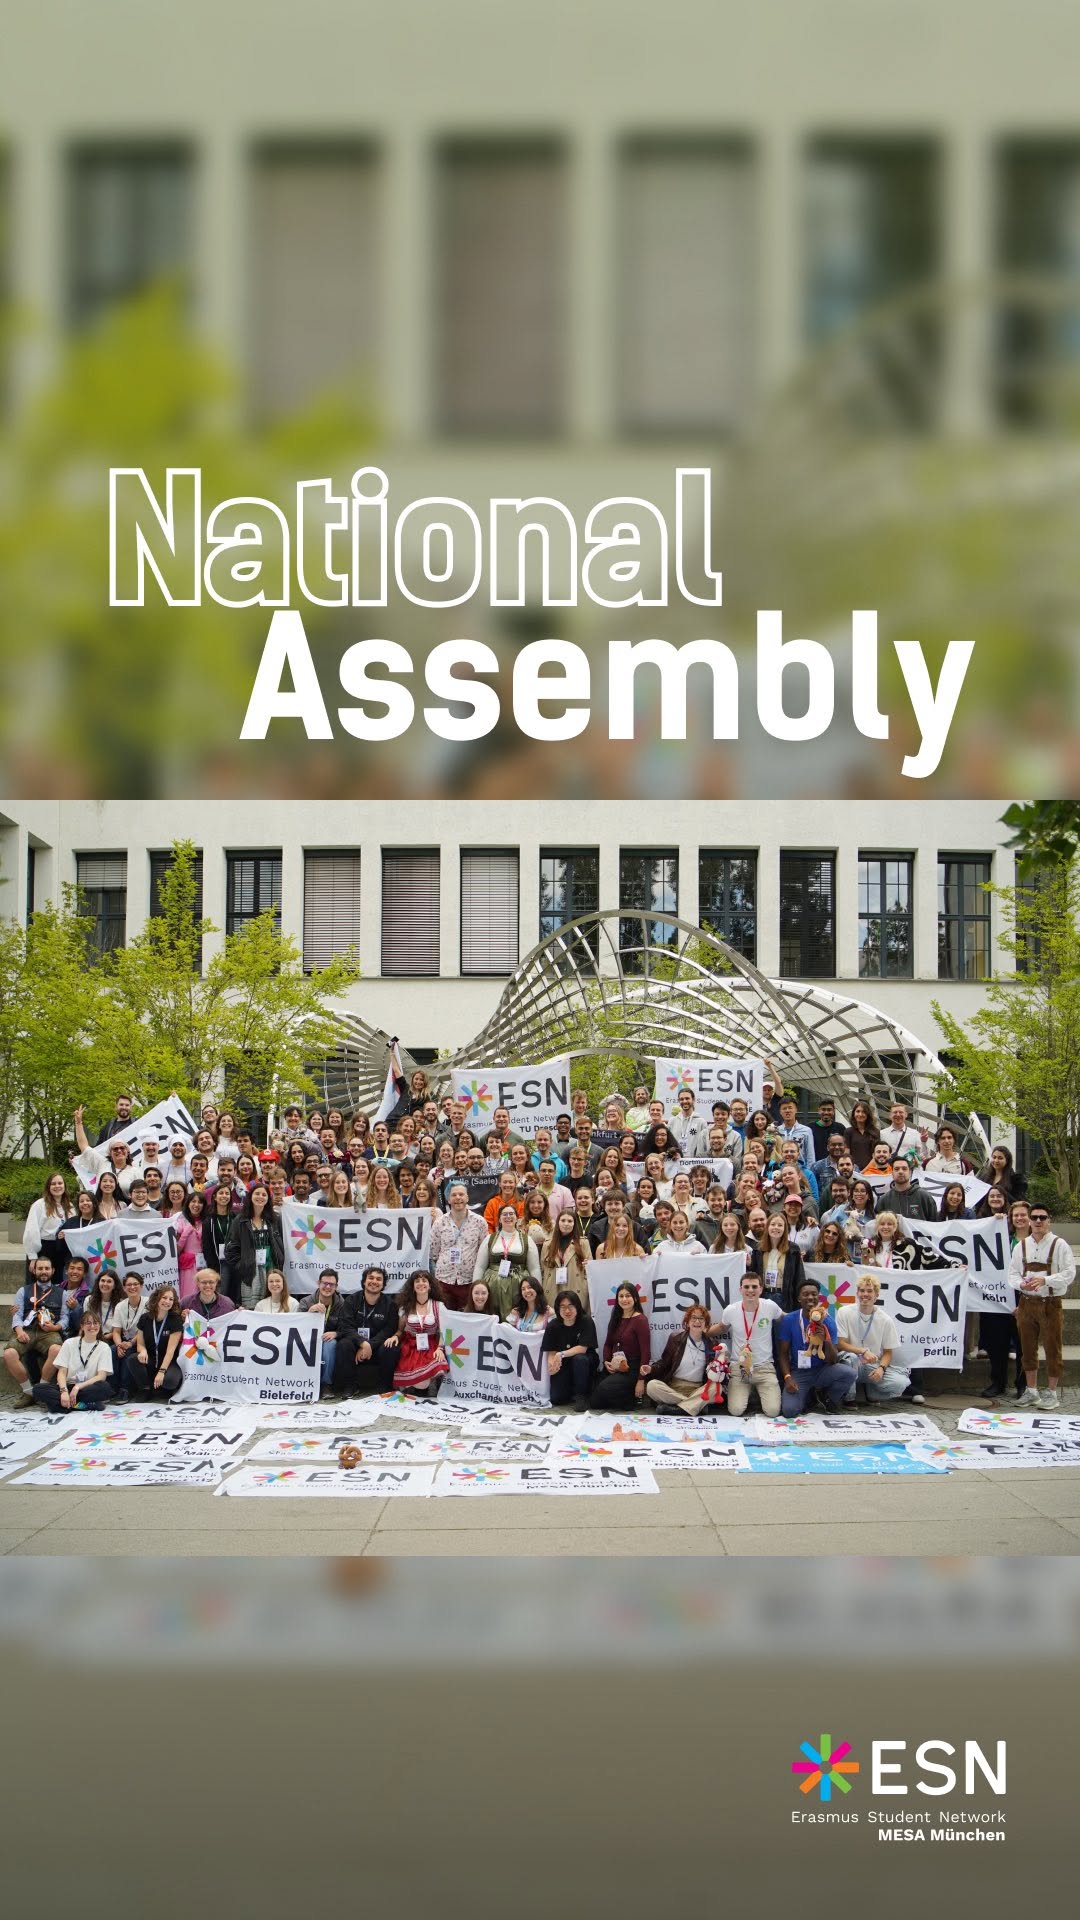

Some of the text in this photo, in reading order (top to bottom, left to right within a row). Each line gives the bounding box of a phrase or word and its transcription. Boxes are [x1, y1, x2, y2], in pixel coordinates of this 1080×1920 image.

[698, 1069, 753, 1092] ESN
[498, 1076, 567, 1110] ESN
[471, 1177, 498, 1186] (Saale)
[339, 1216, 424, 1253] ESN
[290, 1261, 329, 1269] Erasmus
[380, 1260, 421, 1269] Network
[968, 1281, 1006, 1291] etwork
[652, 1277, 730, 1312] ESN
[982, 1292, 1007, 1303] Köln
[911, 1333, 958, 1344] Network
[222, 1324, 319, 1367] ESN
[923, 1346, 957, 1357] Berlin
[477, 1335, 544, 1382] ESN
[265, 1377, 315, 1388] Network
[259, 1390, 314, 1400] Bielefeld
[293, 1410, 352, 1419] ESN
[481, 1412, 567, 1427] ESN
[656, 1417, 717, 1425] ESN
[131, 1431, 243, 1445] ESN
[305, 1470, 411, 1483] ESN
[520, 1466, 638, 1480] ESN
